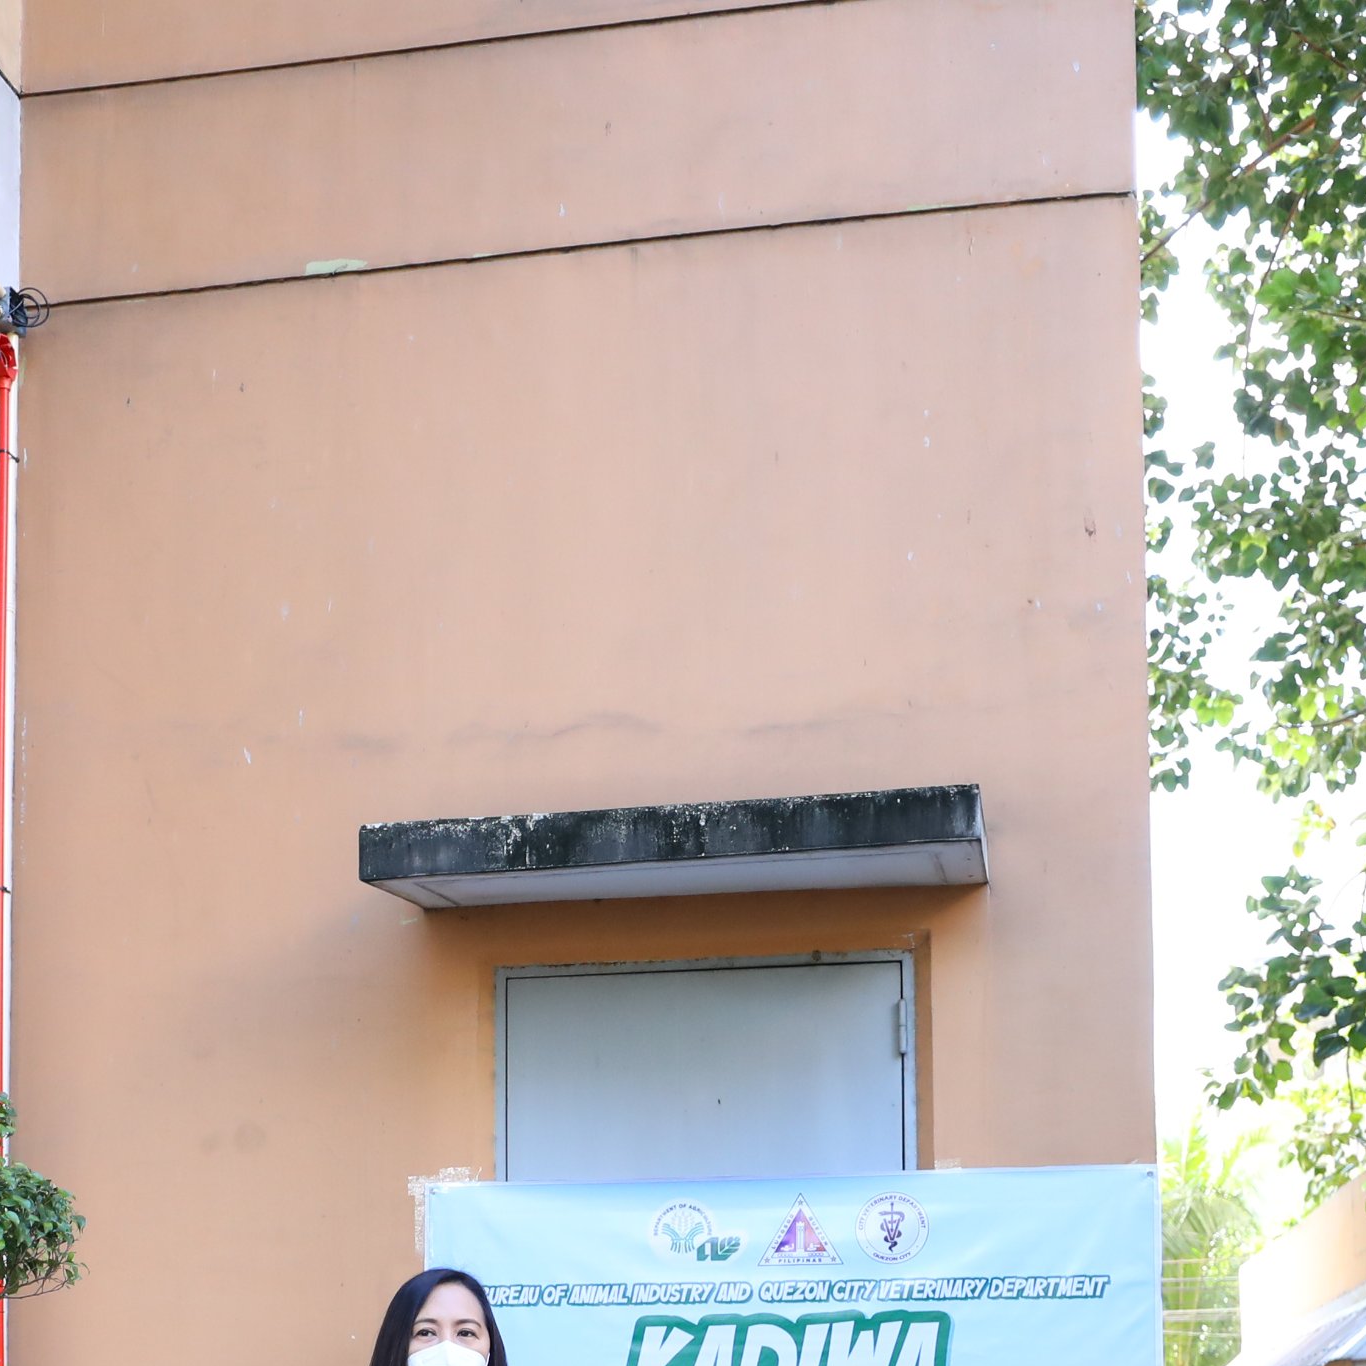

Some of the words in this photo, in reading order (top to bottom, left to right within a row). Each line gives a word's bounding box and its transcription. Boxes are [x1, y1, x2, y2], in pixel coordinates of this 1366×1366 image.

[771, 1213, 794, 1250] LUNGSOD
[808, 1216, 828, 1247] QUEZON
[872, 1252, 897, 1262] QUEZON
[899, 1251, 912, 1261] CITY
[542, 1285, 568, 1304] OF
[569, 1284, 629, 1305] ANIMAL
[631, 1283, 715, 1305] INDUSTRY
[716, 1283, 752, 1303] AND
[759, 1280, 831, 1302] QUEZON
[832, 1279, 878, 1301] CITY
[878, 1278, 988, 1301] VETERINARY
[988, 1275, 1110, 1299] DEPARTMENT
